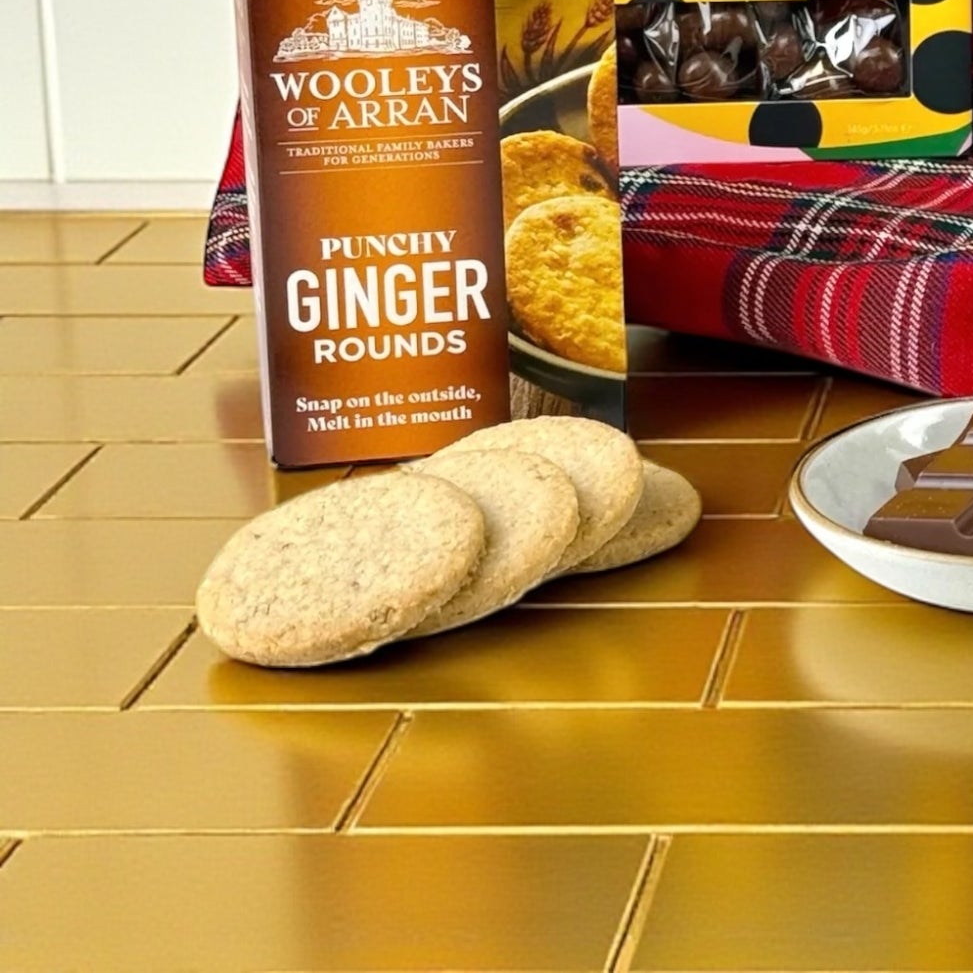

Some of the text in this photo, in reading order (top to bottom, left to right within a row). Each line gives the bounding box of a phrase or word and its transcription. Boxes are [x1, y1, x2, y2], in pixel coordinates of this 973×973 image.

[269, 63, 483, 102] WOOLEYS
[287, 107, 319, 126] OF
[328, 95, 469, 129] ARRAN
[287, 138, 474, 157] TRADITIONAL FAMILY BAKERS
[323, 150, 440, 166] FOR GENERATIONS
[319, 230, 457, 260] PUNCHY
[286, 258, 491, 333] GINGER
[313, 330, 467, 364] ROUNDS
[296, 385, 481, 414] Snap on the outside,
[307, 405, 473, 433] Melt in the mouth
